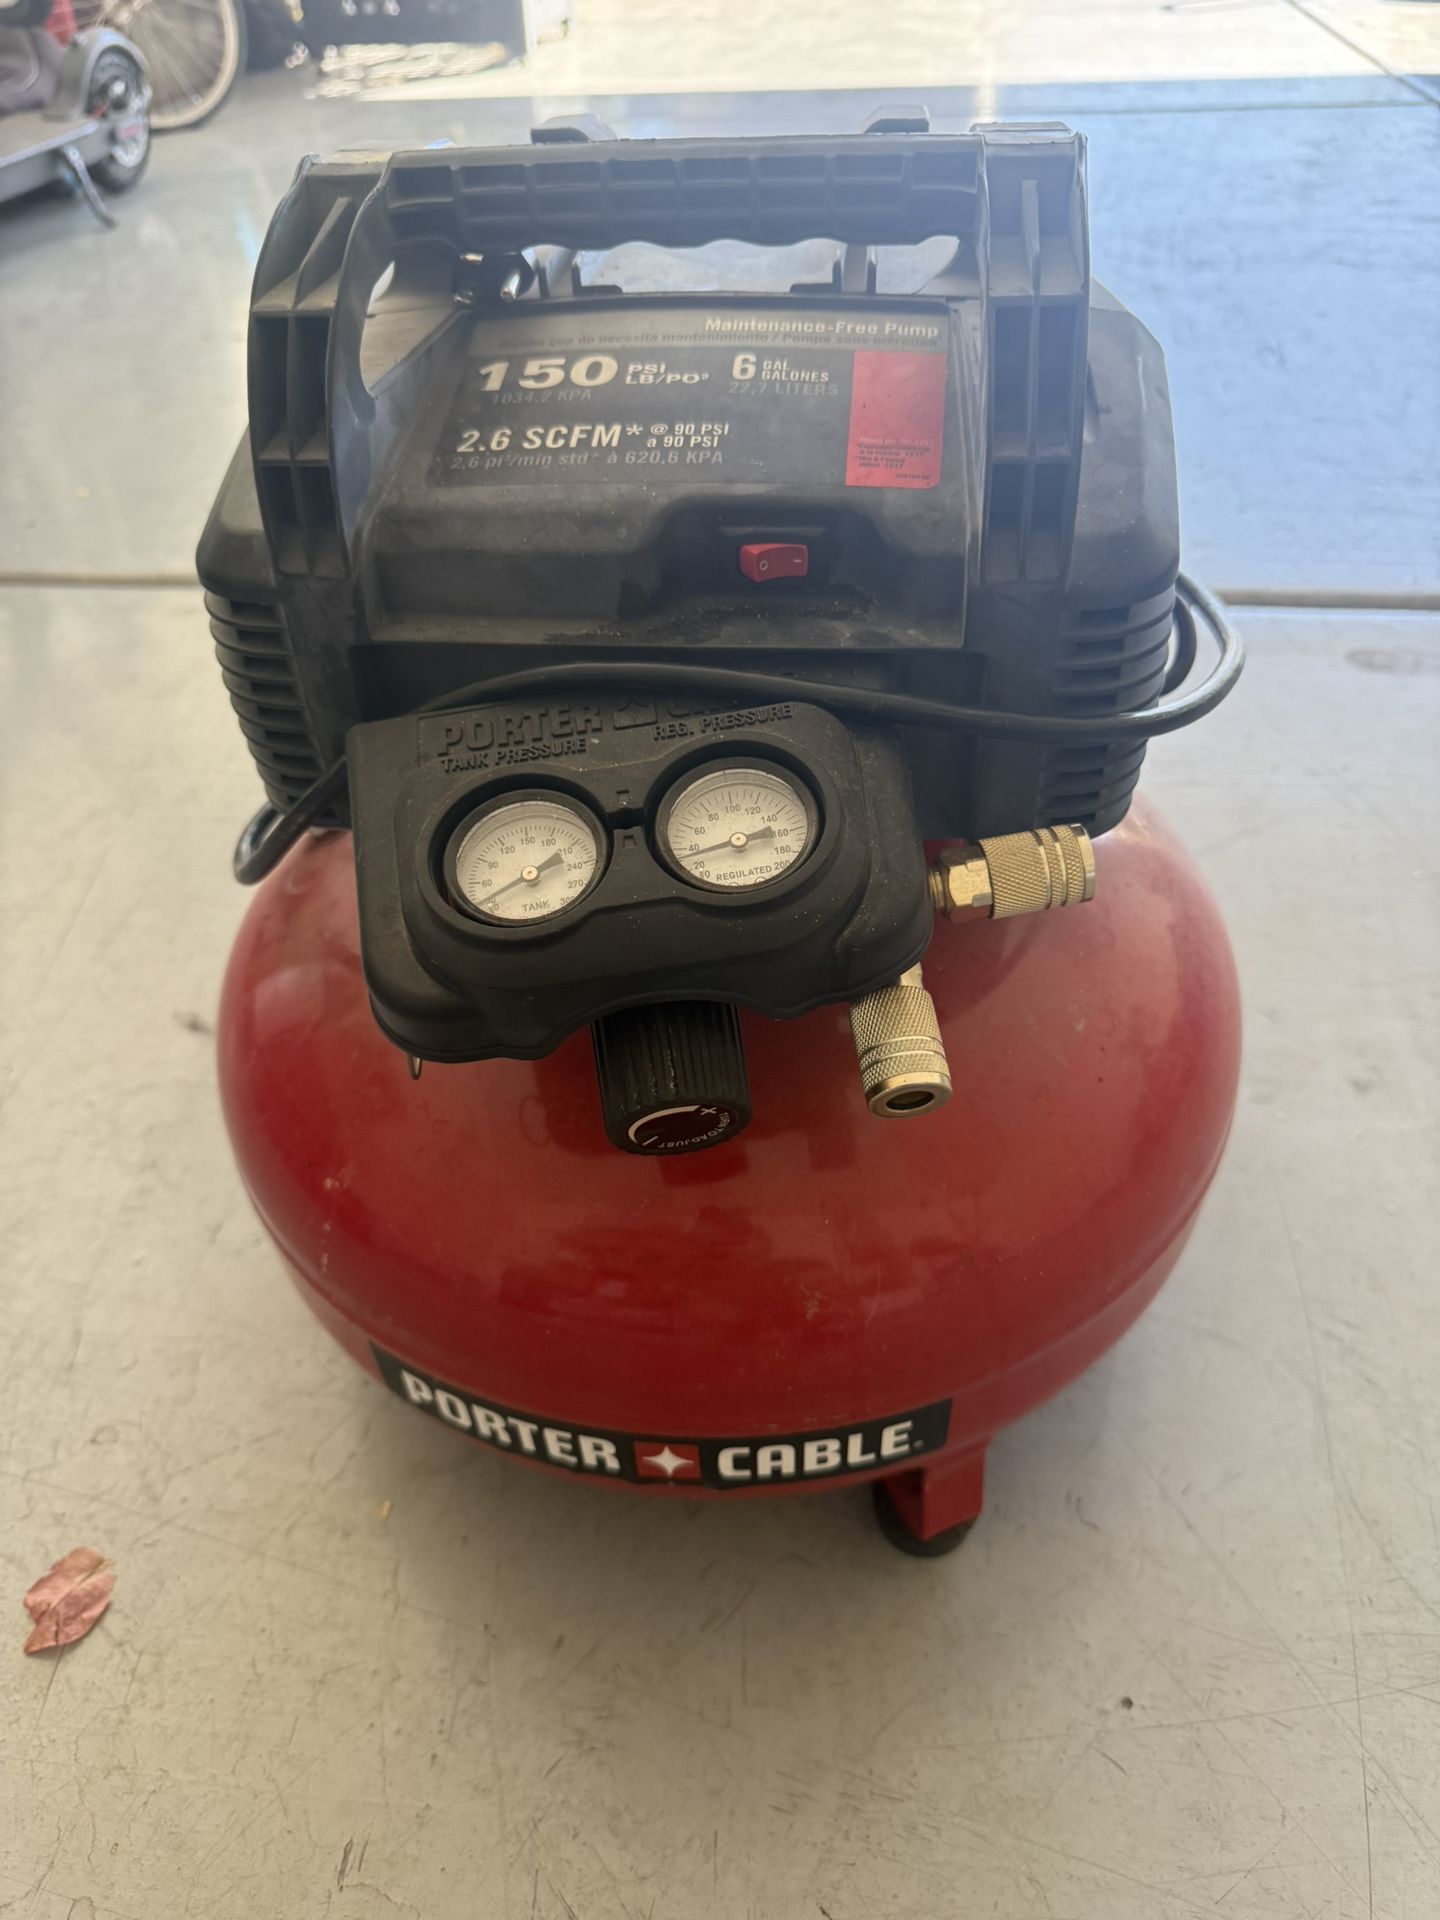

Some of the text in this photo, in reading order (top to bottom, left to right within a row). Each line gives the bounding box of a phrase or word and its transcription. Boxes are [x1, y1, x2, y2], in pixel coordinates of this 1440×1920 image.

[705, 317, 939, 337] Maintenance-Free Pump
[662, 330, 768, 343] mantenimiento
[628, 363, 667, 374] PSI
[732, 354, 758, 380] 6
[763, 361, 791, 371] GAL
[479, 355, 619, 392] 150
[762, 372, 830, 383] GALONES
[775, 382, 839, 396] LITERS
[457, 429, 512, 453] 2.6
[650, 424, 669, 436] @
[674, 424, 695, 436] 90
[701, 424, 730, 436] PSI
[662, 436, 684, 448] 90
[690, 436, 719, 448] PSI
[686, 451, 724, 465] KPA
[654, 722, 694, 741] REG.
[701, 704, 793, 733] PRESSURE
[438, 706, 602, 756] PORTER
[441, 738, 587, 773] TANK PRESSURE
[725, 804, 741, 814] 100
[744, 806, 761, 816] 120
[708, 813, 720, 822] 80
[761, 814, 778, 824] 140
[694, 826, 706, 836] 60
[772, 828, 789, 838] 160
[520, 836, 536, 846] 150
[541, 838, 557, 848] 180
[499, 845, 516, 855] 120
[688, 843, 700, 853] 40
[775, 844, 791, 855] 180
[488, 860, 499, 870] 90
[567, 861, 583, 872] 240
[694, 860, 705, 869] 20
[716, 865, 772, 881] REGULATED
[482, 879, 493, 888] 60
[568, 880, 584, 890] 270
[522, 899, 550, 912] TANK
[401, 1369, 621, 1473] PORTER
